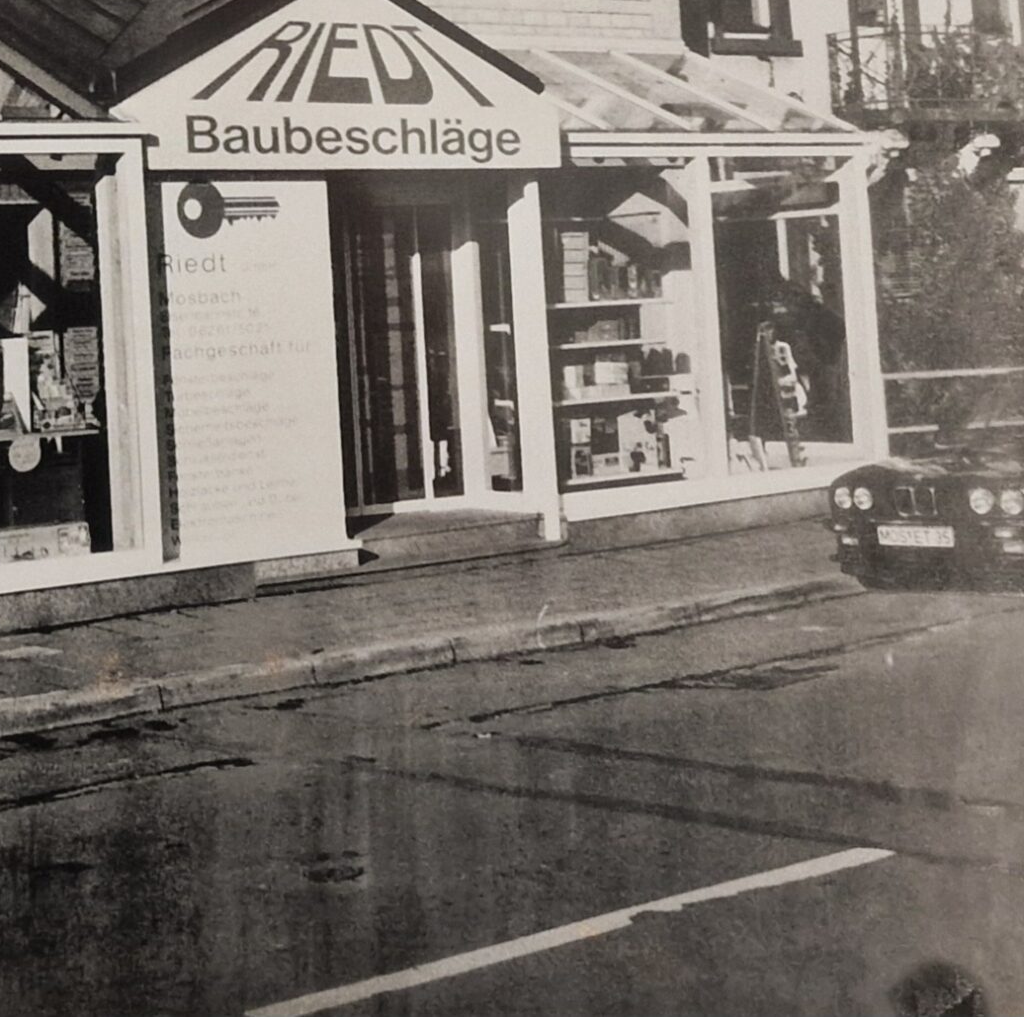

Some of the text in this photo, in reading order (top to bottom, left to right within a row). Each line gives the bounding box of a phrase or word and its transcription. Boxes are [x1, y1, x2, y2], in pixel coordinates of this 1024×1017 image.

[191, 20, 495, 107] RIEDT
[185, 114, 521, 164] Baubeschläge
[159, 253, 228, 274] Riedt
